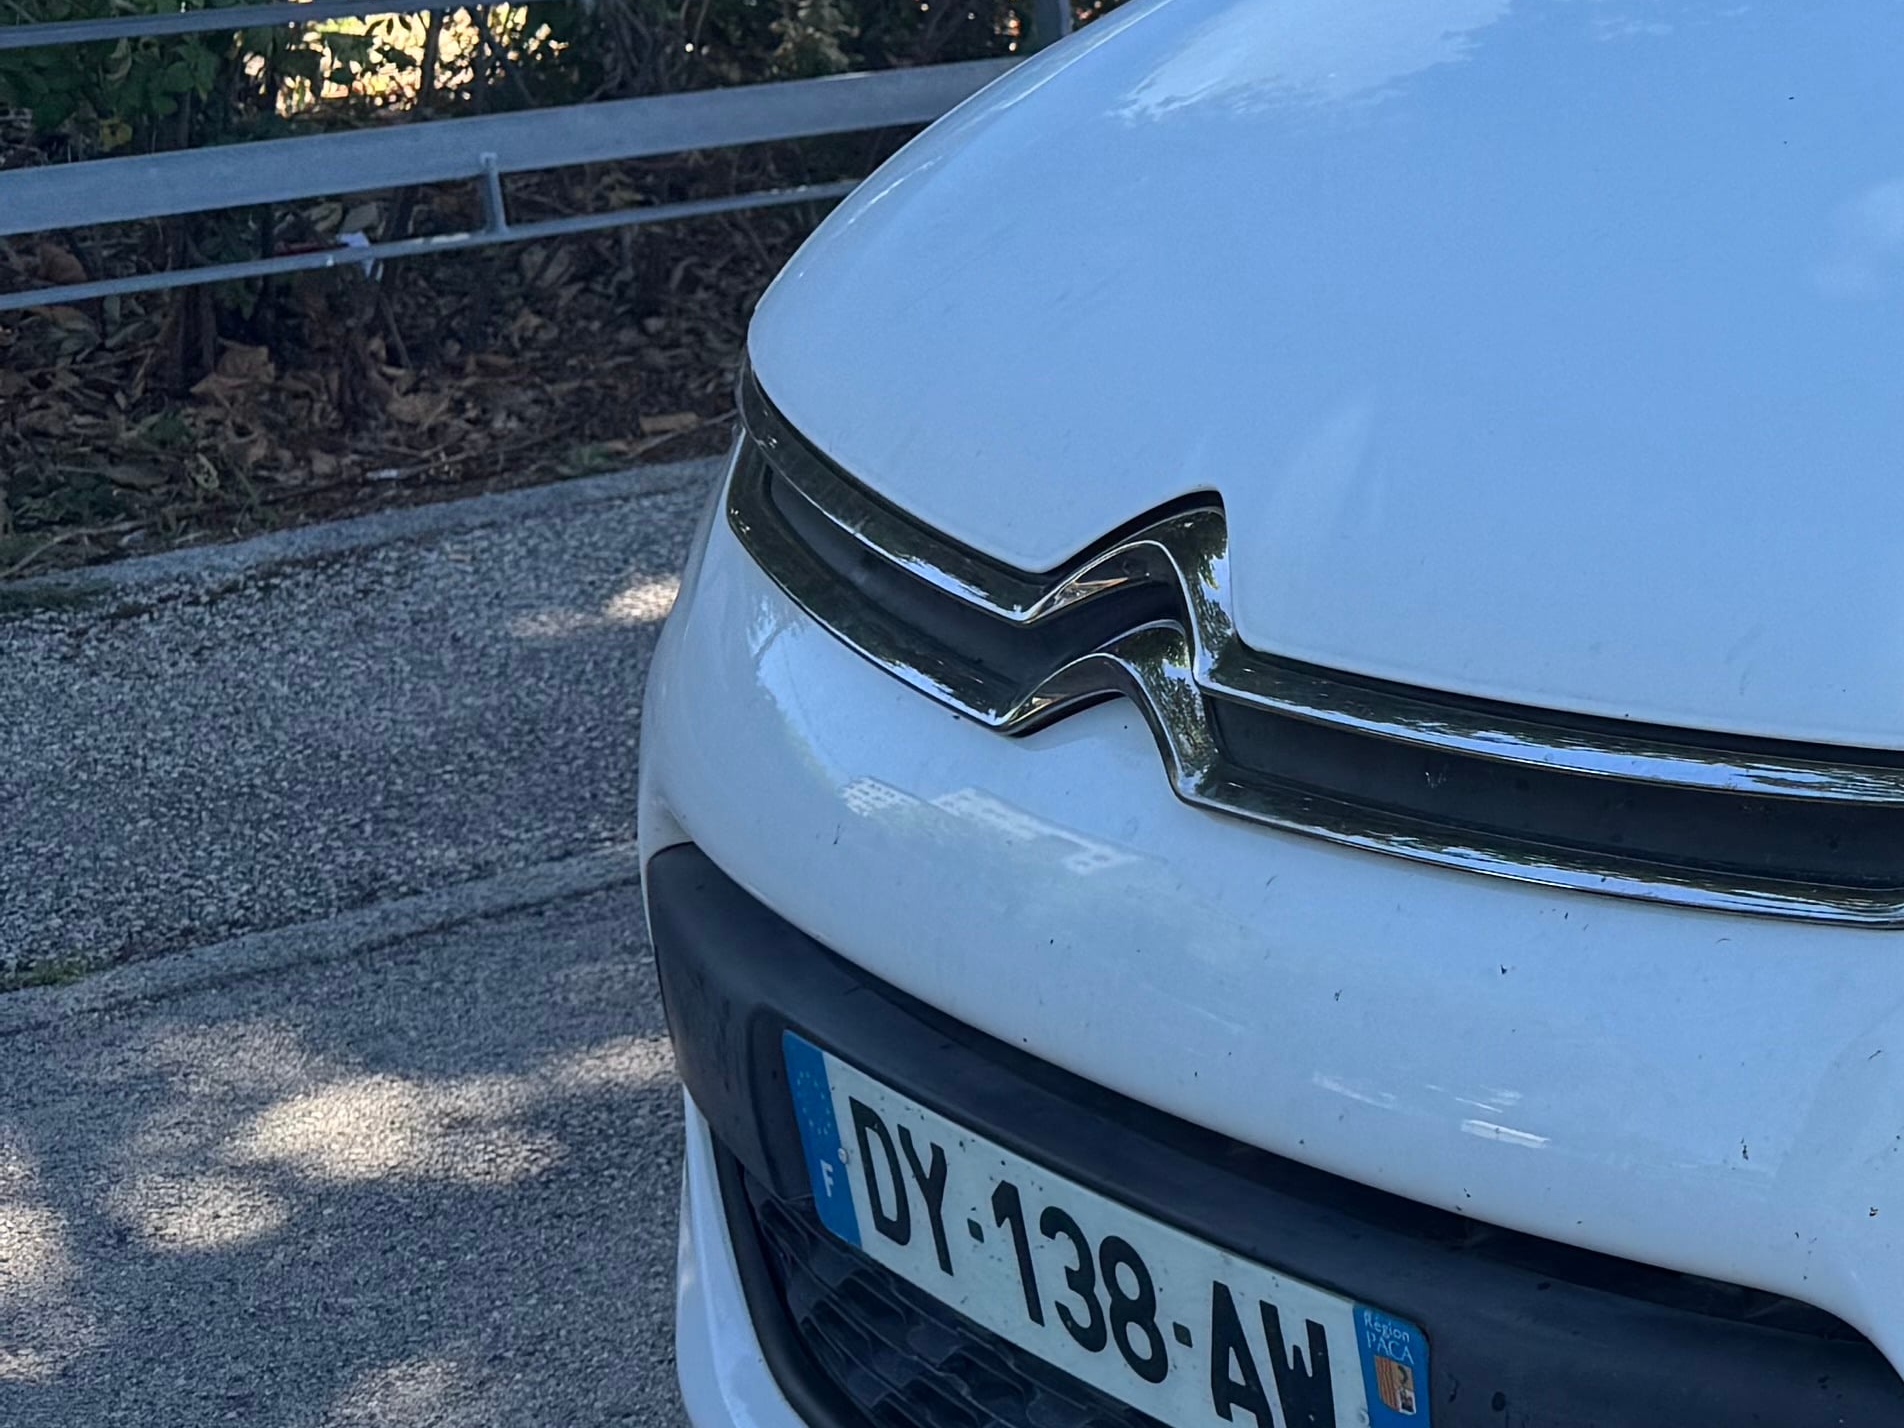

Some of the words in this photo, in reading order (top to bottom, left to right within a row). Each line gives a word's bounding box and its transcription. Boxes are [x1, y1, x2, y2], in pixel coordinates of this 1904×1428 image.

[820, 1162, 835, 1198] F
[1363, 1310, 1411, 1343] Région
[1366, 1331, 1415, 1365] PACA
